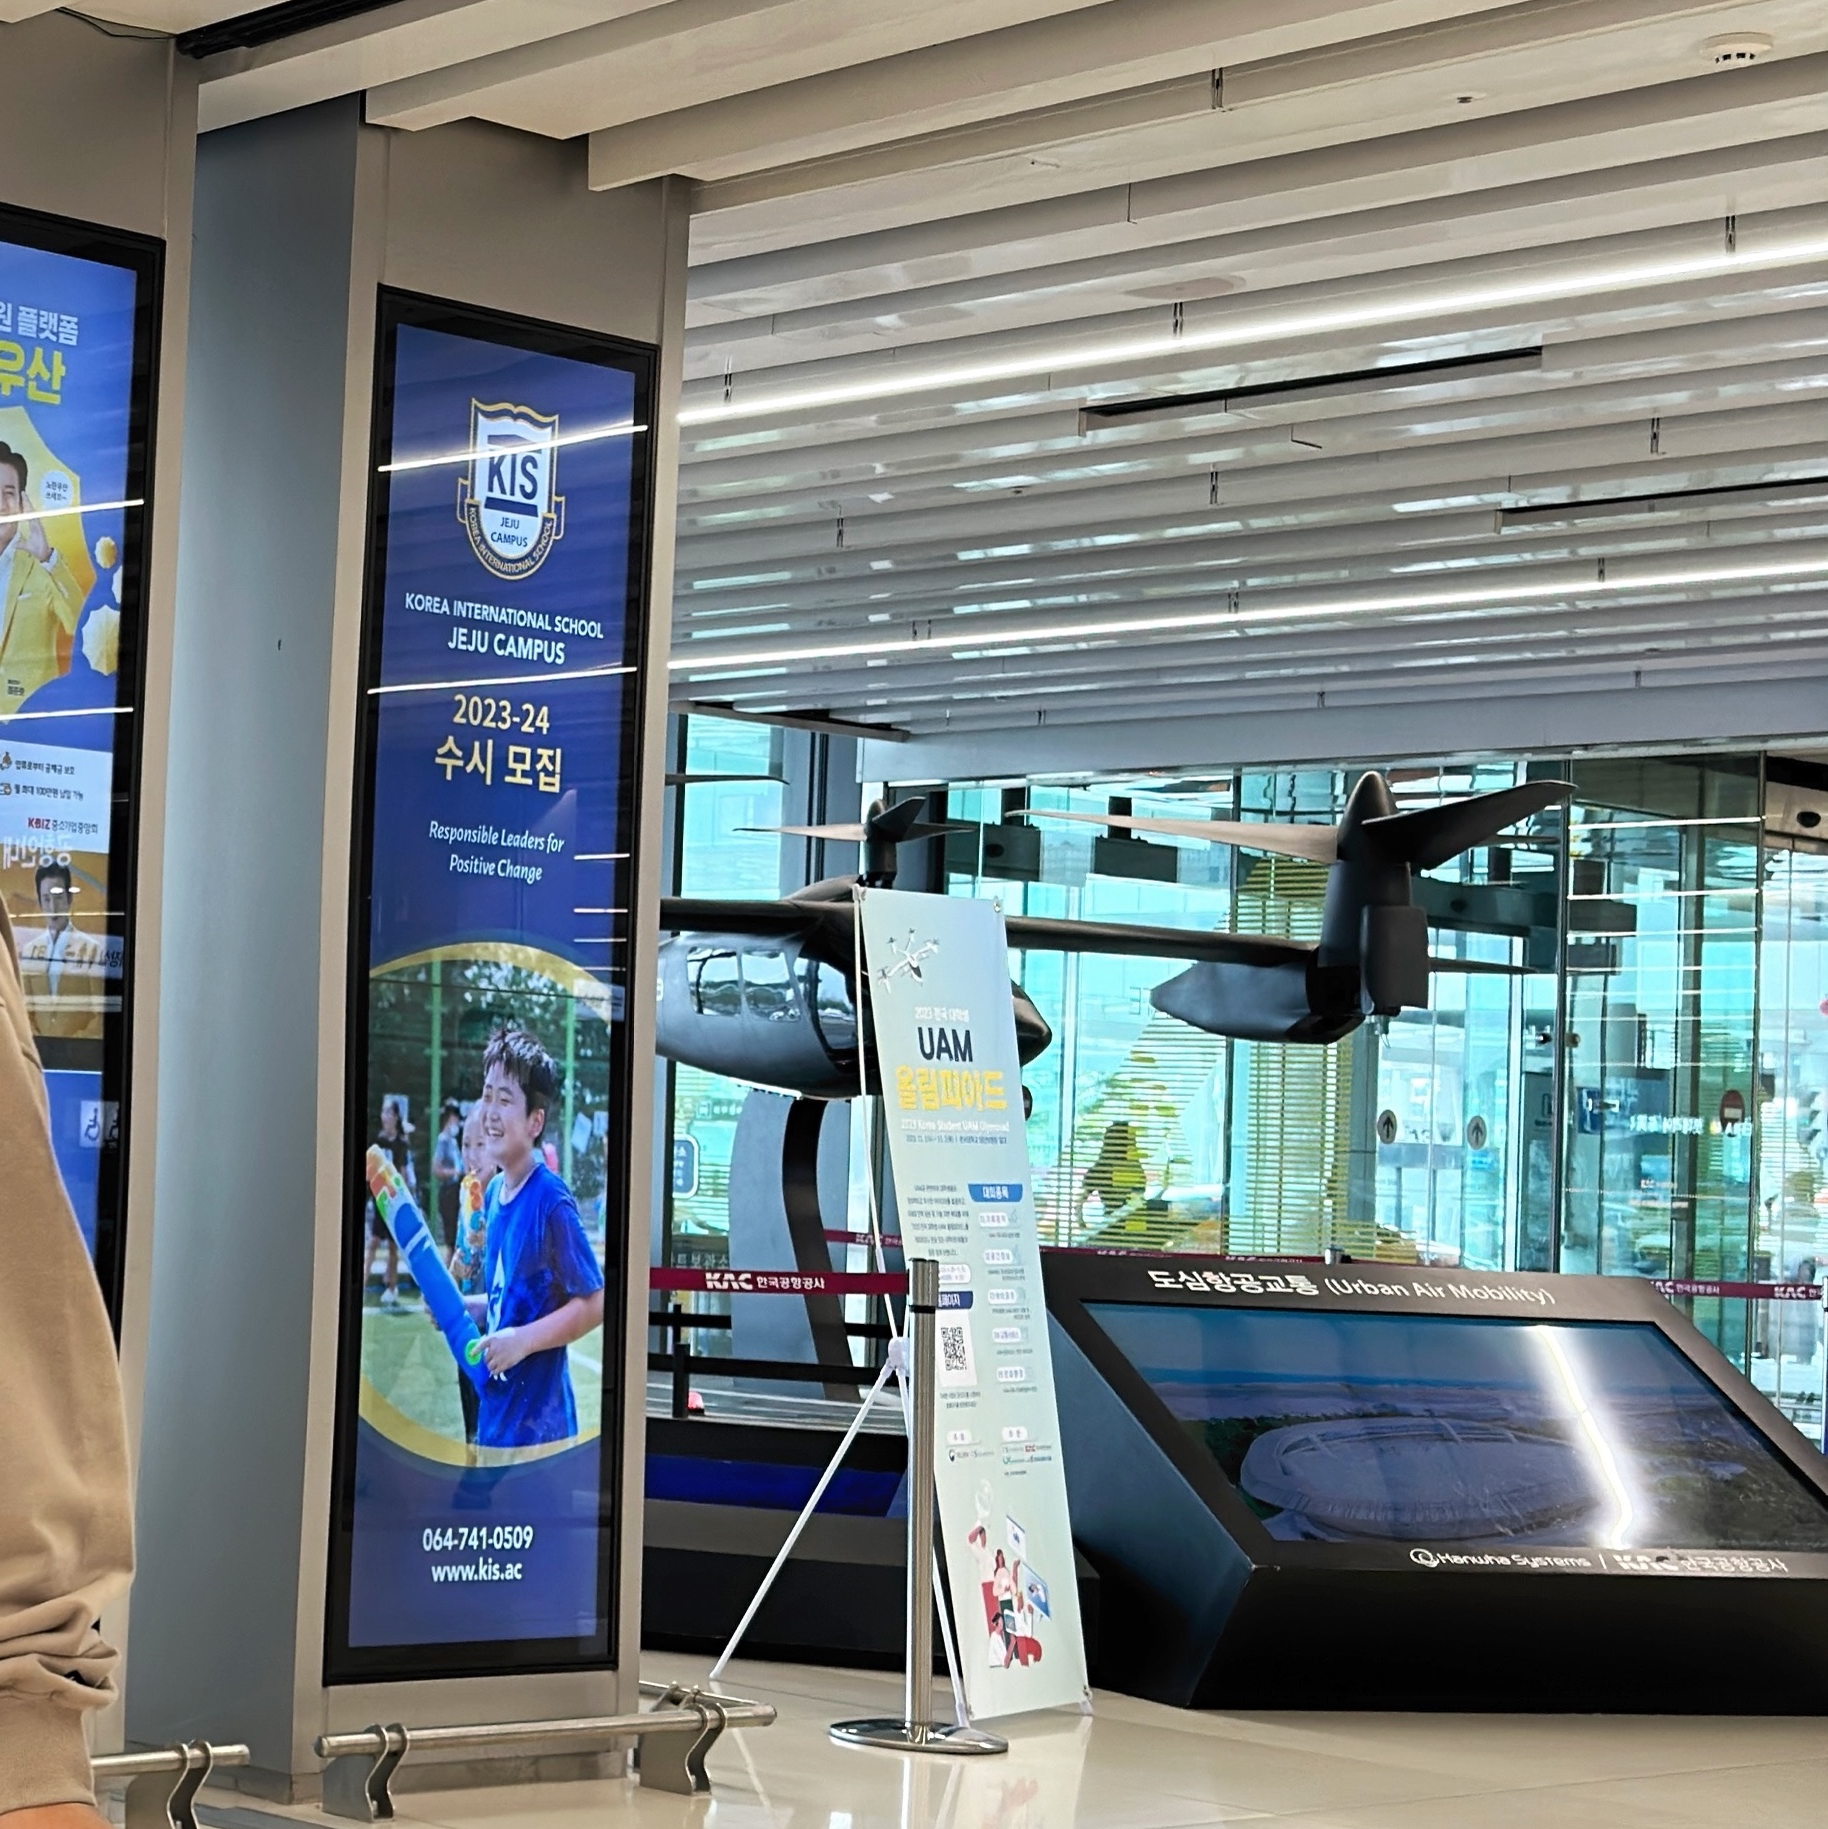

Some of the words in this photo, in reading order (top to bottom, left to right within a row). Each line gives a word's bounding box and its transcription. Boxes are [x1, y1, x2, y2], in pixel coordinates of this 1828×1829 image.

[18, 306, 79, 346] 플랫폼
[487, 453, 538, 500] KIS
[469, 507, 480, 546] KOREA
[478, 543, 535, 573] INTERNATIONAL
[533, 520, 553, 560] SCHOOL
[490, 531, 528, 548] CAMPUS
[500, 516, 520, 529] JEJU
[405, 593, 450, 615] KOREA
[453, 600, 552, 631] INTERNATIONAL
[554, 615, 604, 639] SCHOOL
[448, 627, 489, 654] JEJU
[493, 633, 566, 665] CAMPUS
[453, 694, 550, 735] 2023-24
[435, 735, 493, 786] 수시
[504, 744, 562, 794] 모집
[28, 817, 51, 830] KBIZ
[429, 820, 499, 845] Responsible
[500, 829, 545, 850] Leaders
[546, 832, 565, 855] for
[449, 854, 496, 876] Positive
[497, 859, 543, 885] Change
[917, 1026, 973, 1062] UAM
[896, 1064, 1008, 1112] 올림피아드
[705, 1271, 754, 1290] KAC
[757, 1276, 825, 1290] 한국공항공사
[1148, 1270, 1280, 1296] 도심항공교통
[1324, 1278, 1410, 1297] (Urban
[1412, 1282, 1447, 1299] Air
[1448, 1284, 1556, 1306] Mobility)
[1775, 1286, 1807, 1299] KAC
[422, 1526, 534, 1551] 064-741-0509
[431, 1557, 523, 1582] www.kis.ac
[1437, 1552, 1511, 1566] Hanwha
[1511, 1554, 1592, 1568] Systems
